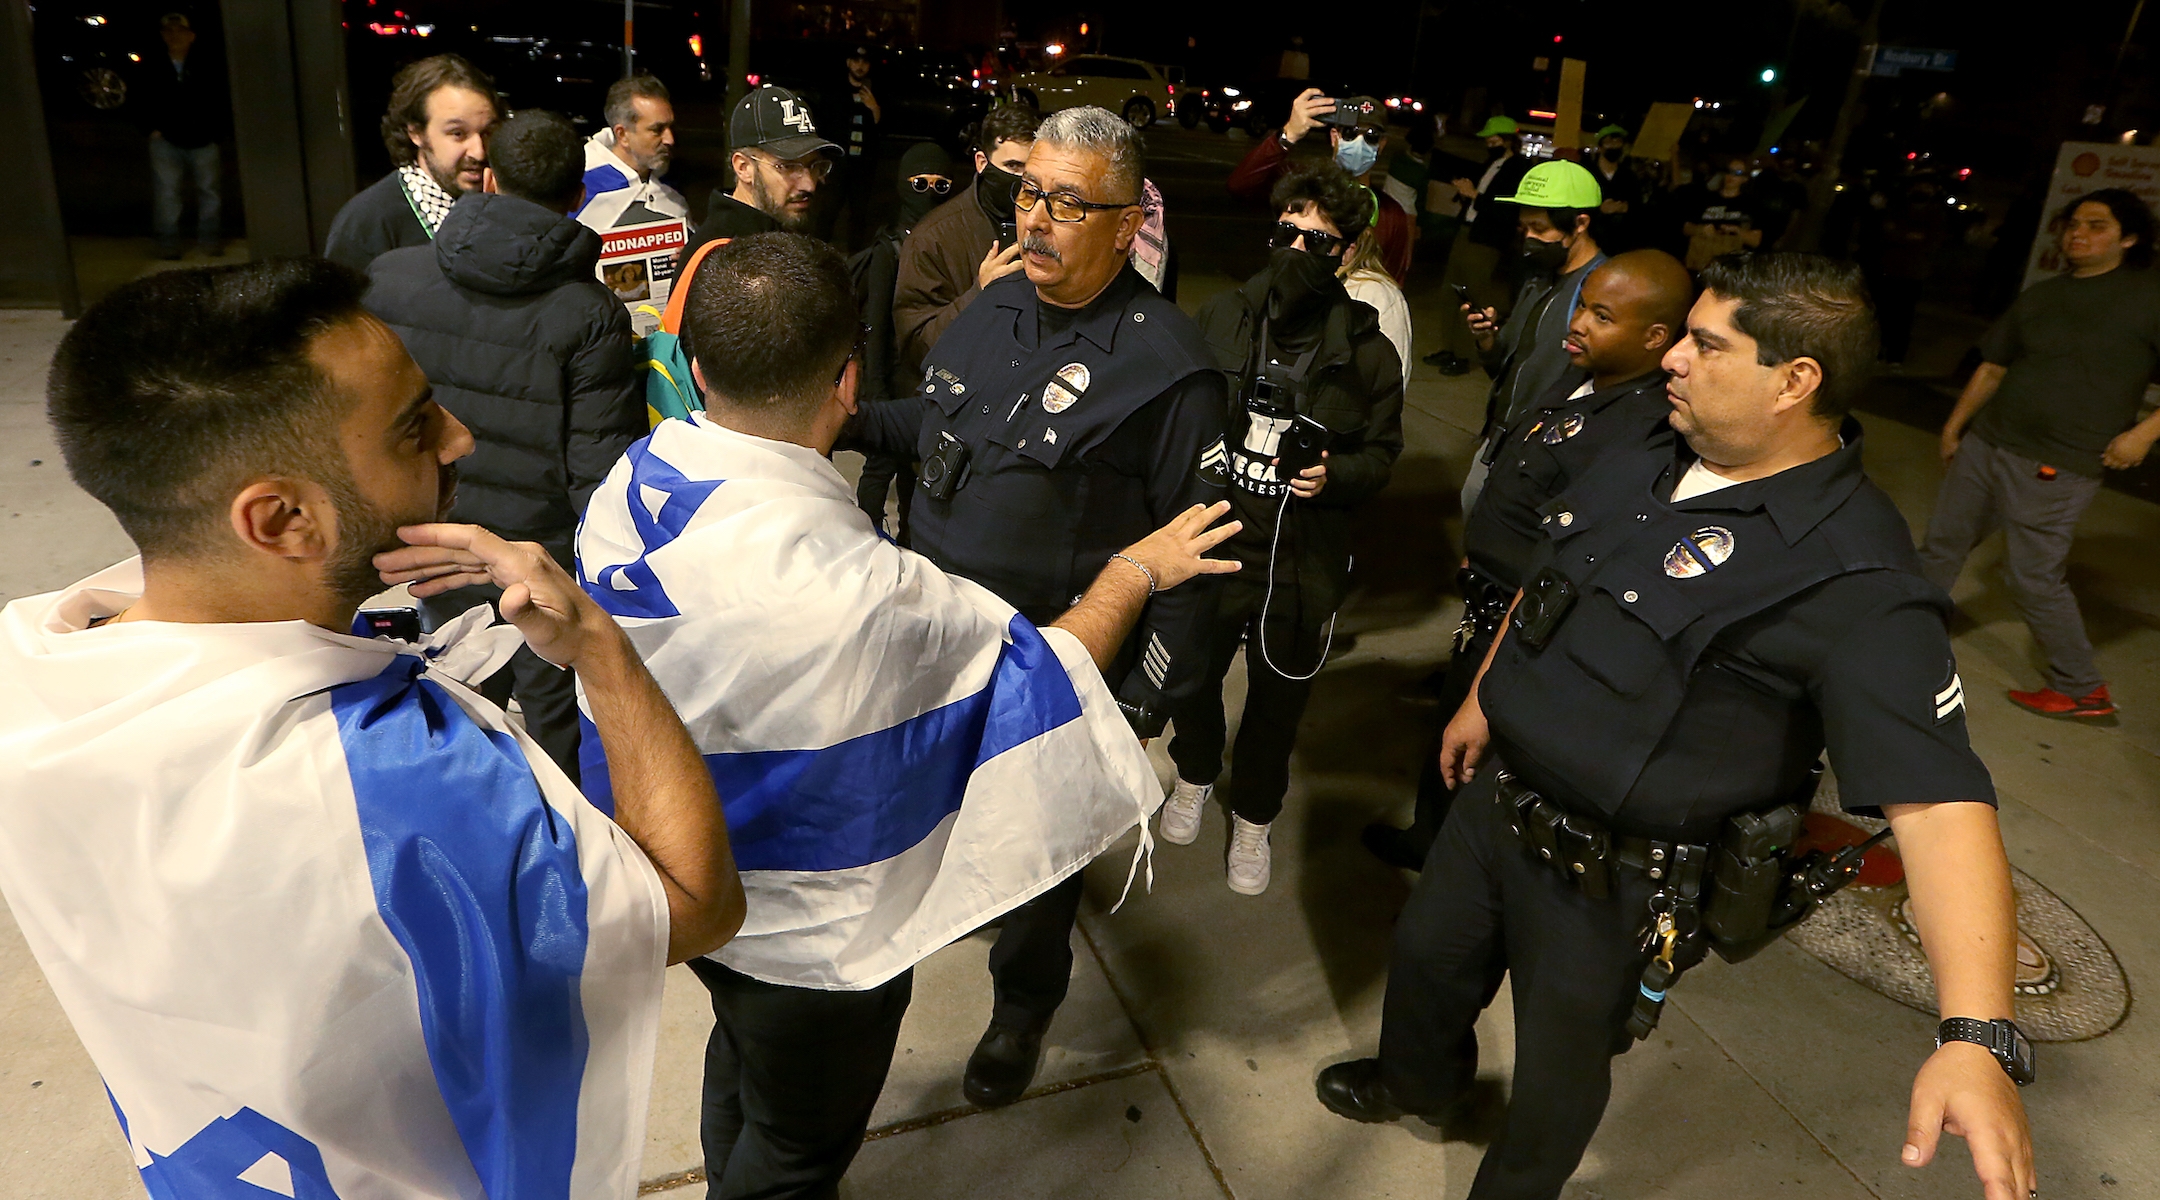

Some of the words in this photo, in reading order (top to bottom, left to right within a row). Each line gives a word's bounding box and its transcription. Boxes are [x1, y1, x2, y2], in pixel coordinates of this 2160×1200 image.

[779, 99, 816, 133] LA
[601, 230, 683, 254] KIDNAPPED
[1232, 451, 1281, 483] EGA
[1232, 472, 1287, 496] PALEST
